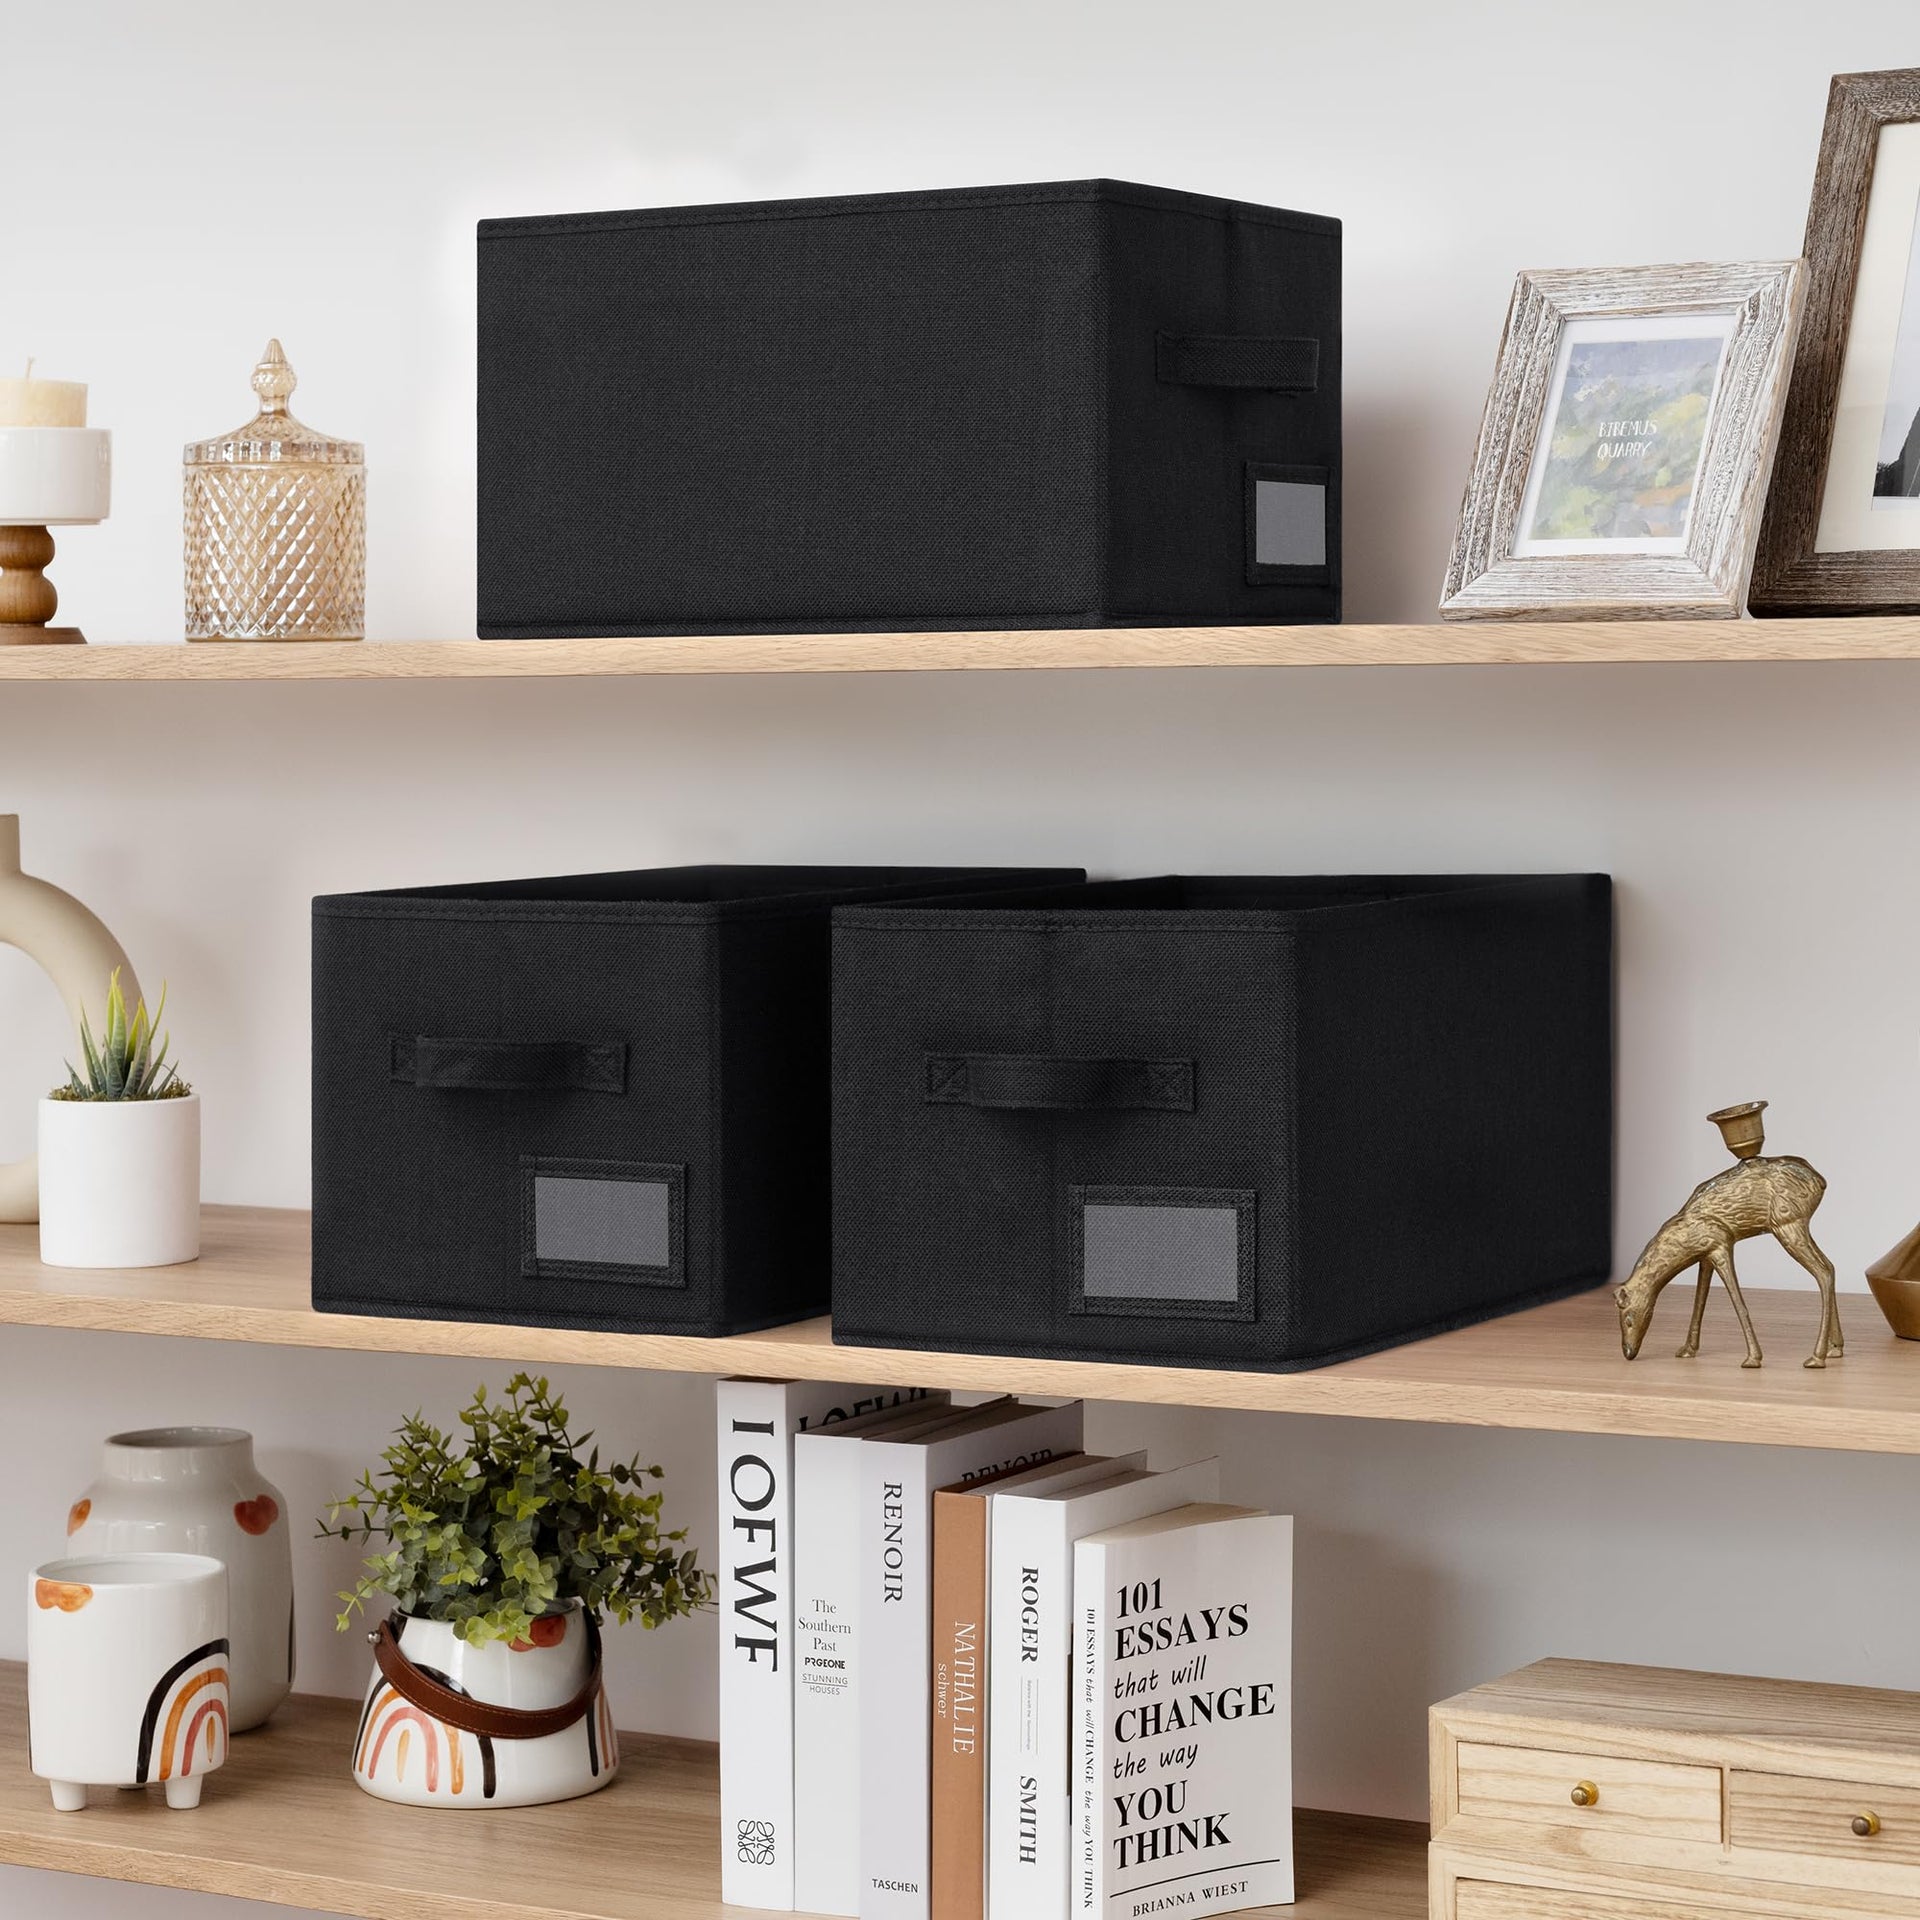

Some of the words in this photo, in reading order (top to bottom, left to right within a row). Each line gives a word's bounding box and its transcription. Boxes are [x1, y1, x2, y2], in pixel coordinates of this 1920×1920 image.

[1597, 440, 1653, 460] QUARRY
[883, 1481, 903, 1603] RENOIR
[811, 1598, 837, 1614] The
[1021, 1566, 1039, 1663] ROGER
[1086, 1608, 1095, 1625] 101
[1116, 1577, 1164, 1619] 101
[798, 1617, 852, 1634] Southern
[813, 1637, 837, 1652] Past
[1114, 1603, 1249, 1662] ESSAYS
[1086, 1628, 1096, 1675] ESSAYS
[802, 1673, 848, 1686] STUNNING
[809, 1684, 841, 1696] HOUSES
[937, 1663, 950, 1719] schwer
[953, 1621, 976, 1755] NATHALIE
[1085, 1678, 1095, 1704] that
[1114, 1669, 1159, 1699] that
[1171, 1654, 1207, 1686] will
[1085, 1709, 1095, 1729] will
[1114, 1683, 1276, 1743] CHANGE
[1085, 1730, 1095, 1784] CHANGE
[1113, 1751, 1147, 1779] the
[1160, 1743, 1199, 1770] way
[1084, 1790, 1094, 1809] the
[1113, 1779, 1188, 1829] YOU
[1019, 1775, 1038, 1866] SMITH
[1082, 1815, 1092, 1837] way
[1084, 1839, 1094, 1867] YOU
[1113, 1812, 1232, 1870] THINK
[872, 1878, 919, 1894] TASCHEN
[1084, 1868, 1093, 1909] THINK
[1132, 1891, 1196, 1918] BRIANNA
[1202, 1880, 1249, 1900] WIEST
